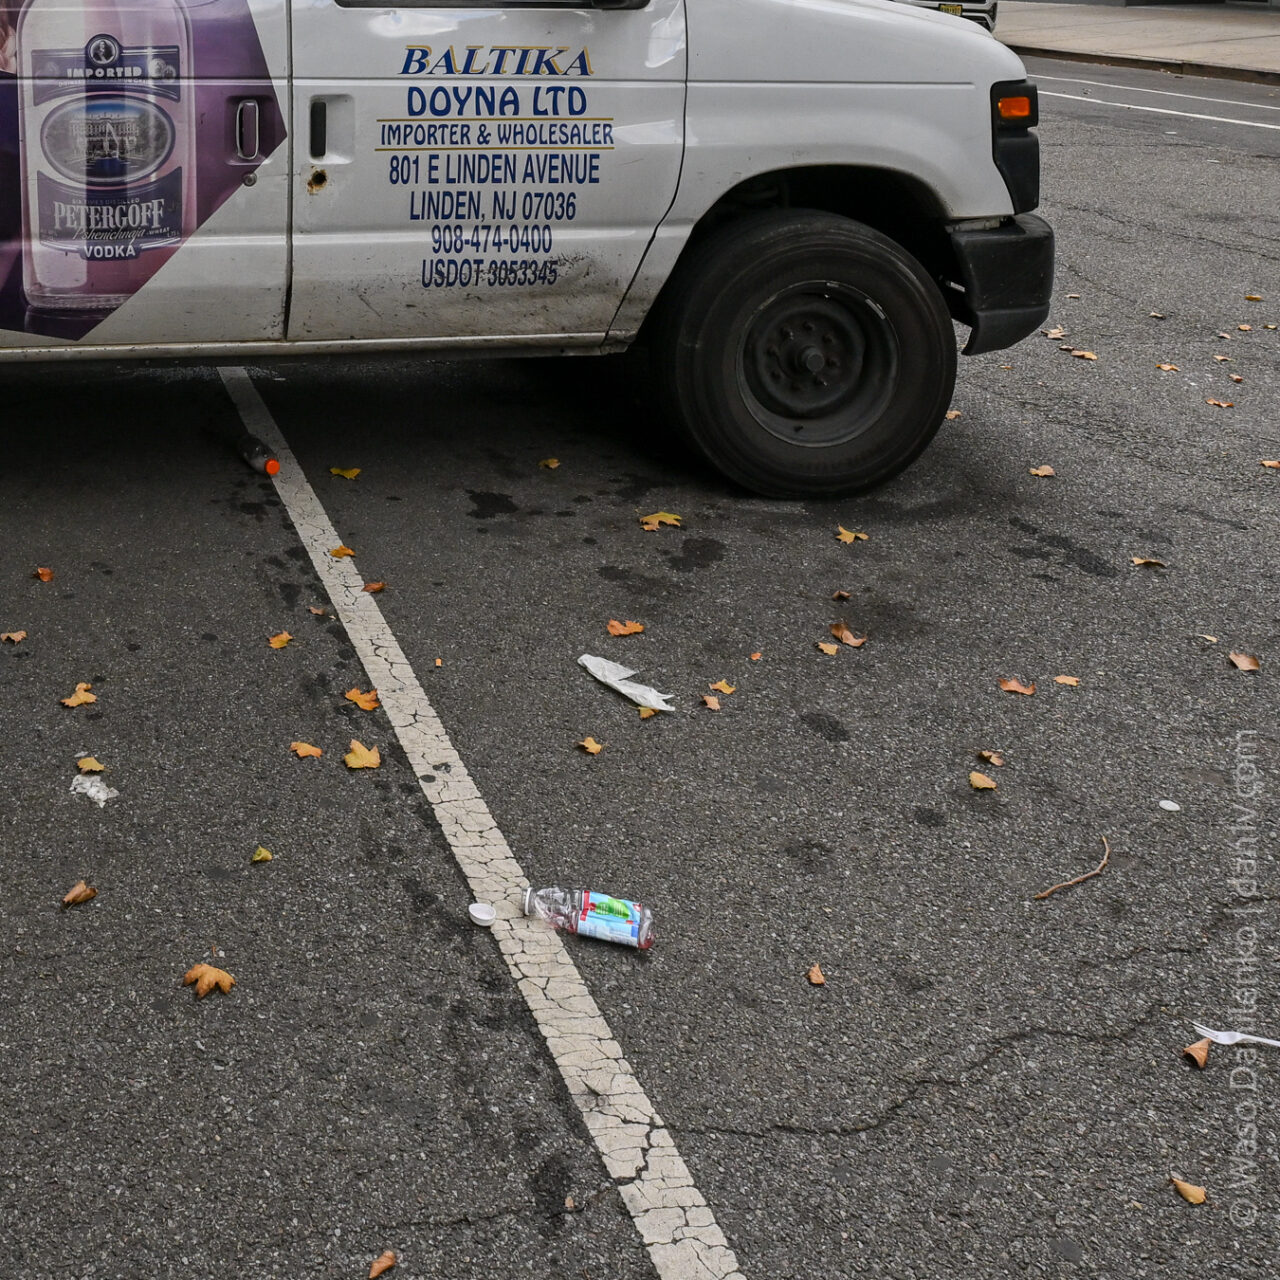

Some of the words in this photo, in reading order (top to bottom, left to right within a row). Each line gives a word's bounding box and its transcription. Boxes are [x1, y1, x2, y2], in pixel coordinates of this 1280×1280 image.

[66, 66, 143, 78] IMPORTED
[397, 45, 595, 77] BALTIKA
[407, 86, 520, 117] DOYNA
[532, 86, 587, 116] LTD
[380, 123, 472, 146] IMPORTER
[476, 123, 492, 145] &
[497, 123, 615, 145] WHOLESALER
[389, 154, 420, 185] 801
[428, 154, 440, 184] E
[446, 154, 517, 184] LINDEN
[522, 153, 600, 184] AVENUE
[53, 198, 165, 230] PETERGOFF
[409, 191, 485, 222] LINDEN,
[492, 191, 517, 221] NJ
[522, 191, 577, 221] 07036
[84, 245, 136, 258] VODKA
[431, 223, 553, 254] 908-474-0400
[421, 258, 484, 288] USDOT
[487, 259, 558, 286] 3053345
